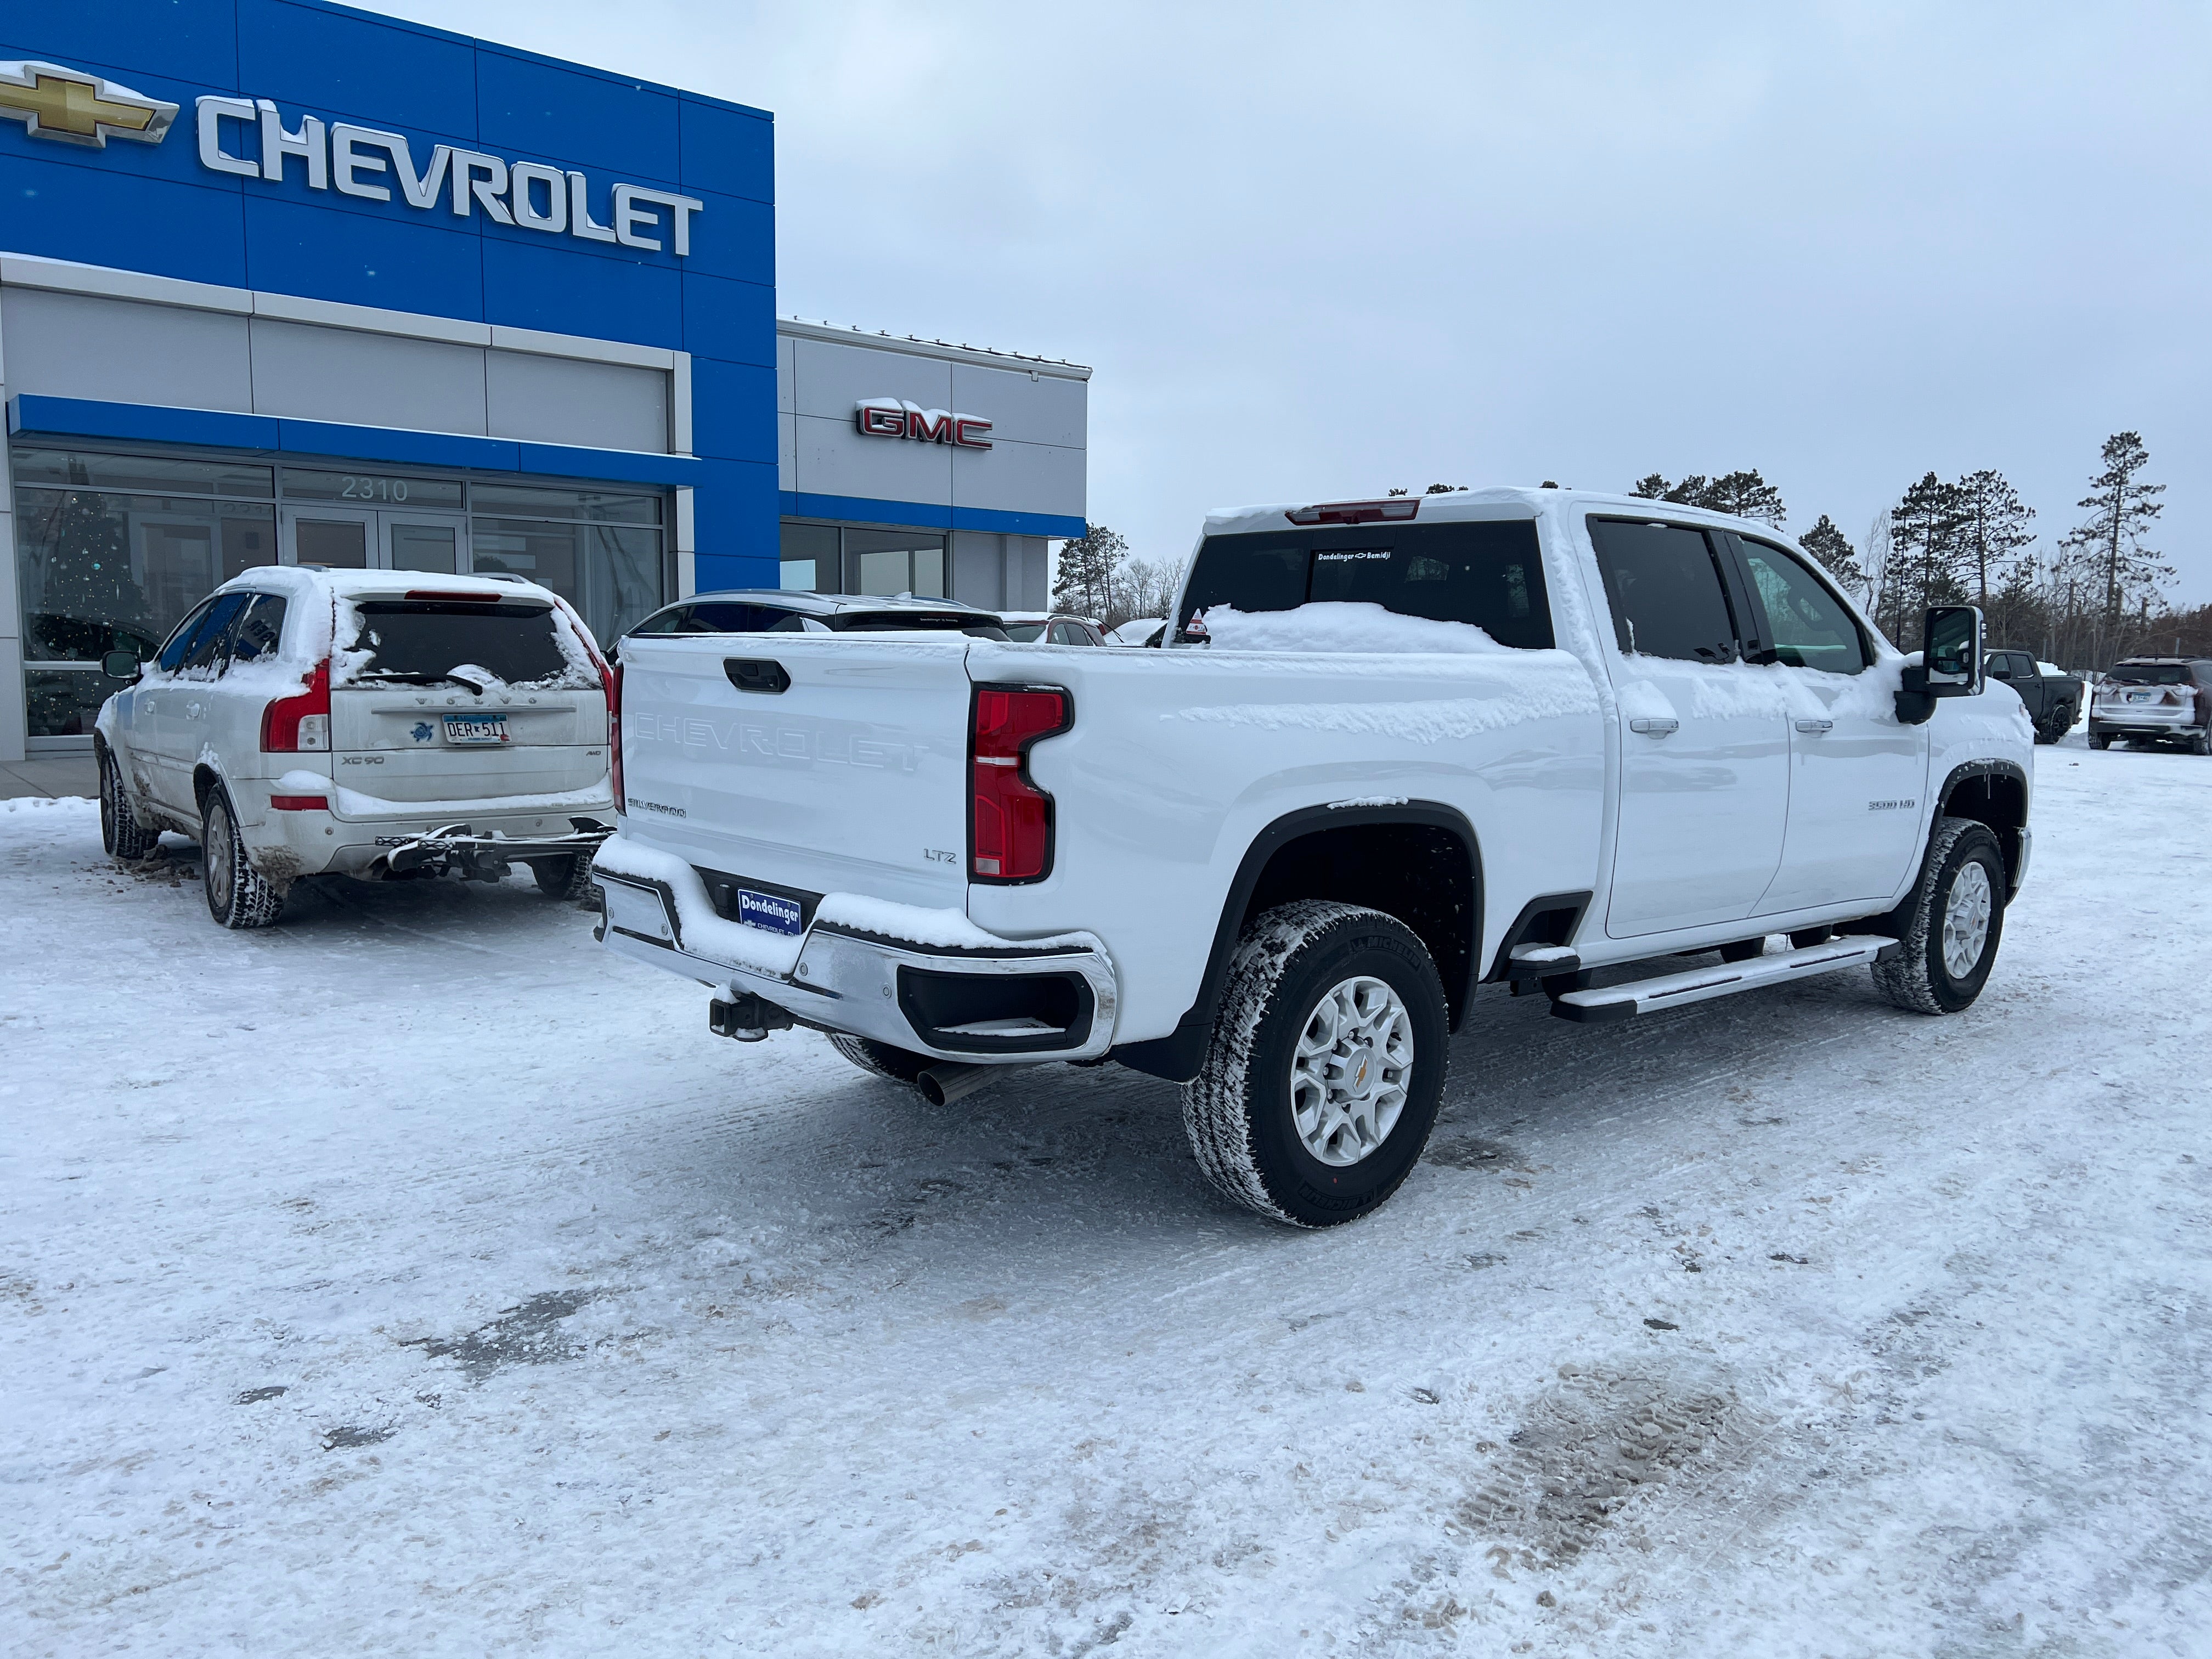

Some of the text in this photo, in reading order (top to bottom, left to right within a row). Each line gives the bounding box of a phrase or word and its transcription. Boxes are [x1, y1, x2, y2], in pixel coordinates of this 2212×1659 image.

[196, 95, 703, 256] CHEVROLET
[857, 406, 993, 450] GMC
[342, 476, 408, 501] 2310
[1318, 551, 1391, 562] Dondelinger Bemidji
[415, 697, 537, 705] VOLVO
[447, 723, 505, 737] DER 511
[635, 712, 930, 772] CHEVROLET
[628, 798, 687, 818] SILVERADO
[1869, 799, 1915, 810] 3500 HD
[923, 848, 957, 865] LTZ
[741, 894, 798, 925] Dondelinger
[757, 923, 785, 935] CHEVROLET
[1367, 935, 1421, 970] MICHELIN
